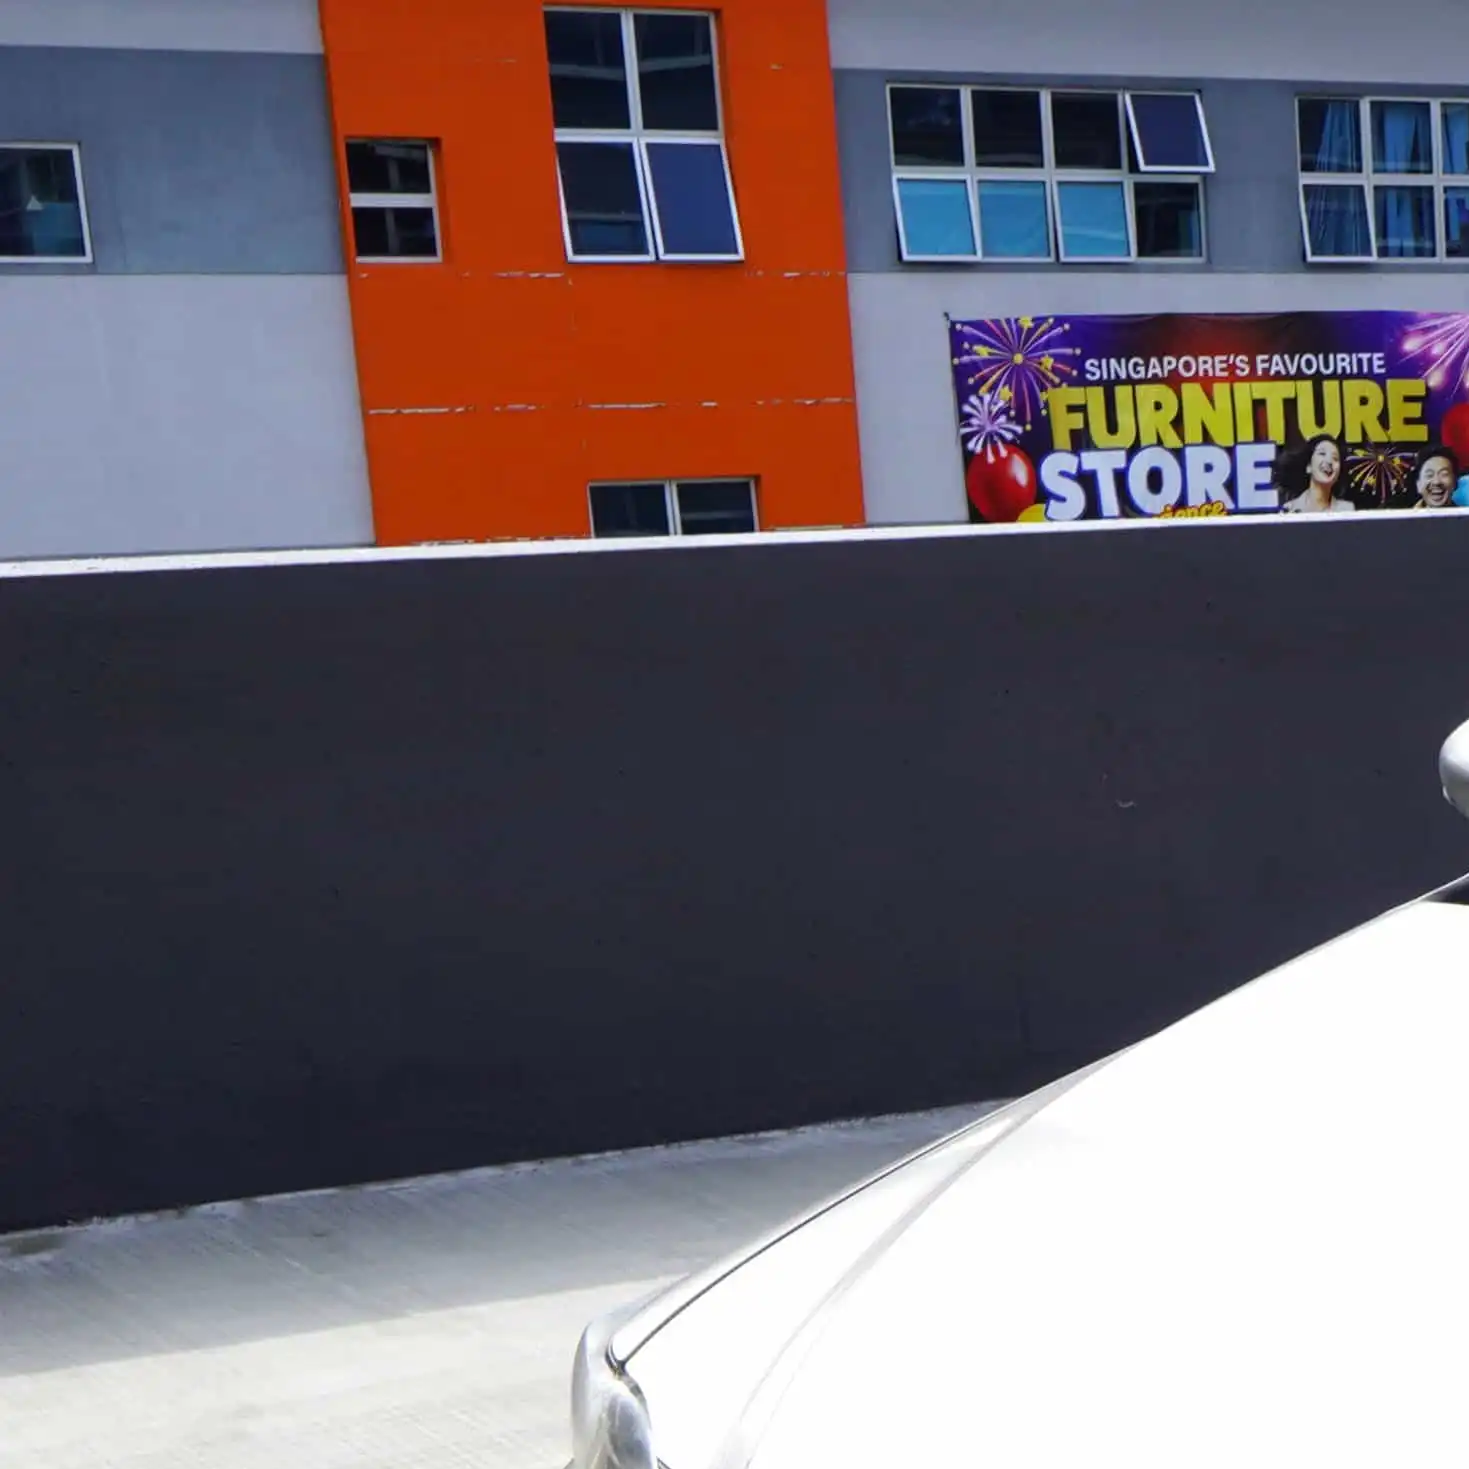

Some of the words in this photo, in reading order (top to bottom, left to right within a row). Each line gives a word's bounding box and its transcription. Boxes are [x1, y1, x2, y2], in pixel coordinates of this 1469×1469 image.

[1085, 353, 1249, 381] SINGAPORE'S
[1256, 352, 1386, 377] FAVOURITE
[1050, 379, 1428, 450] FURNITURE
[1041, 444, 1278, 520] STORE
